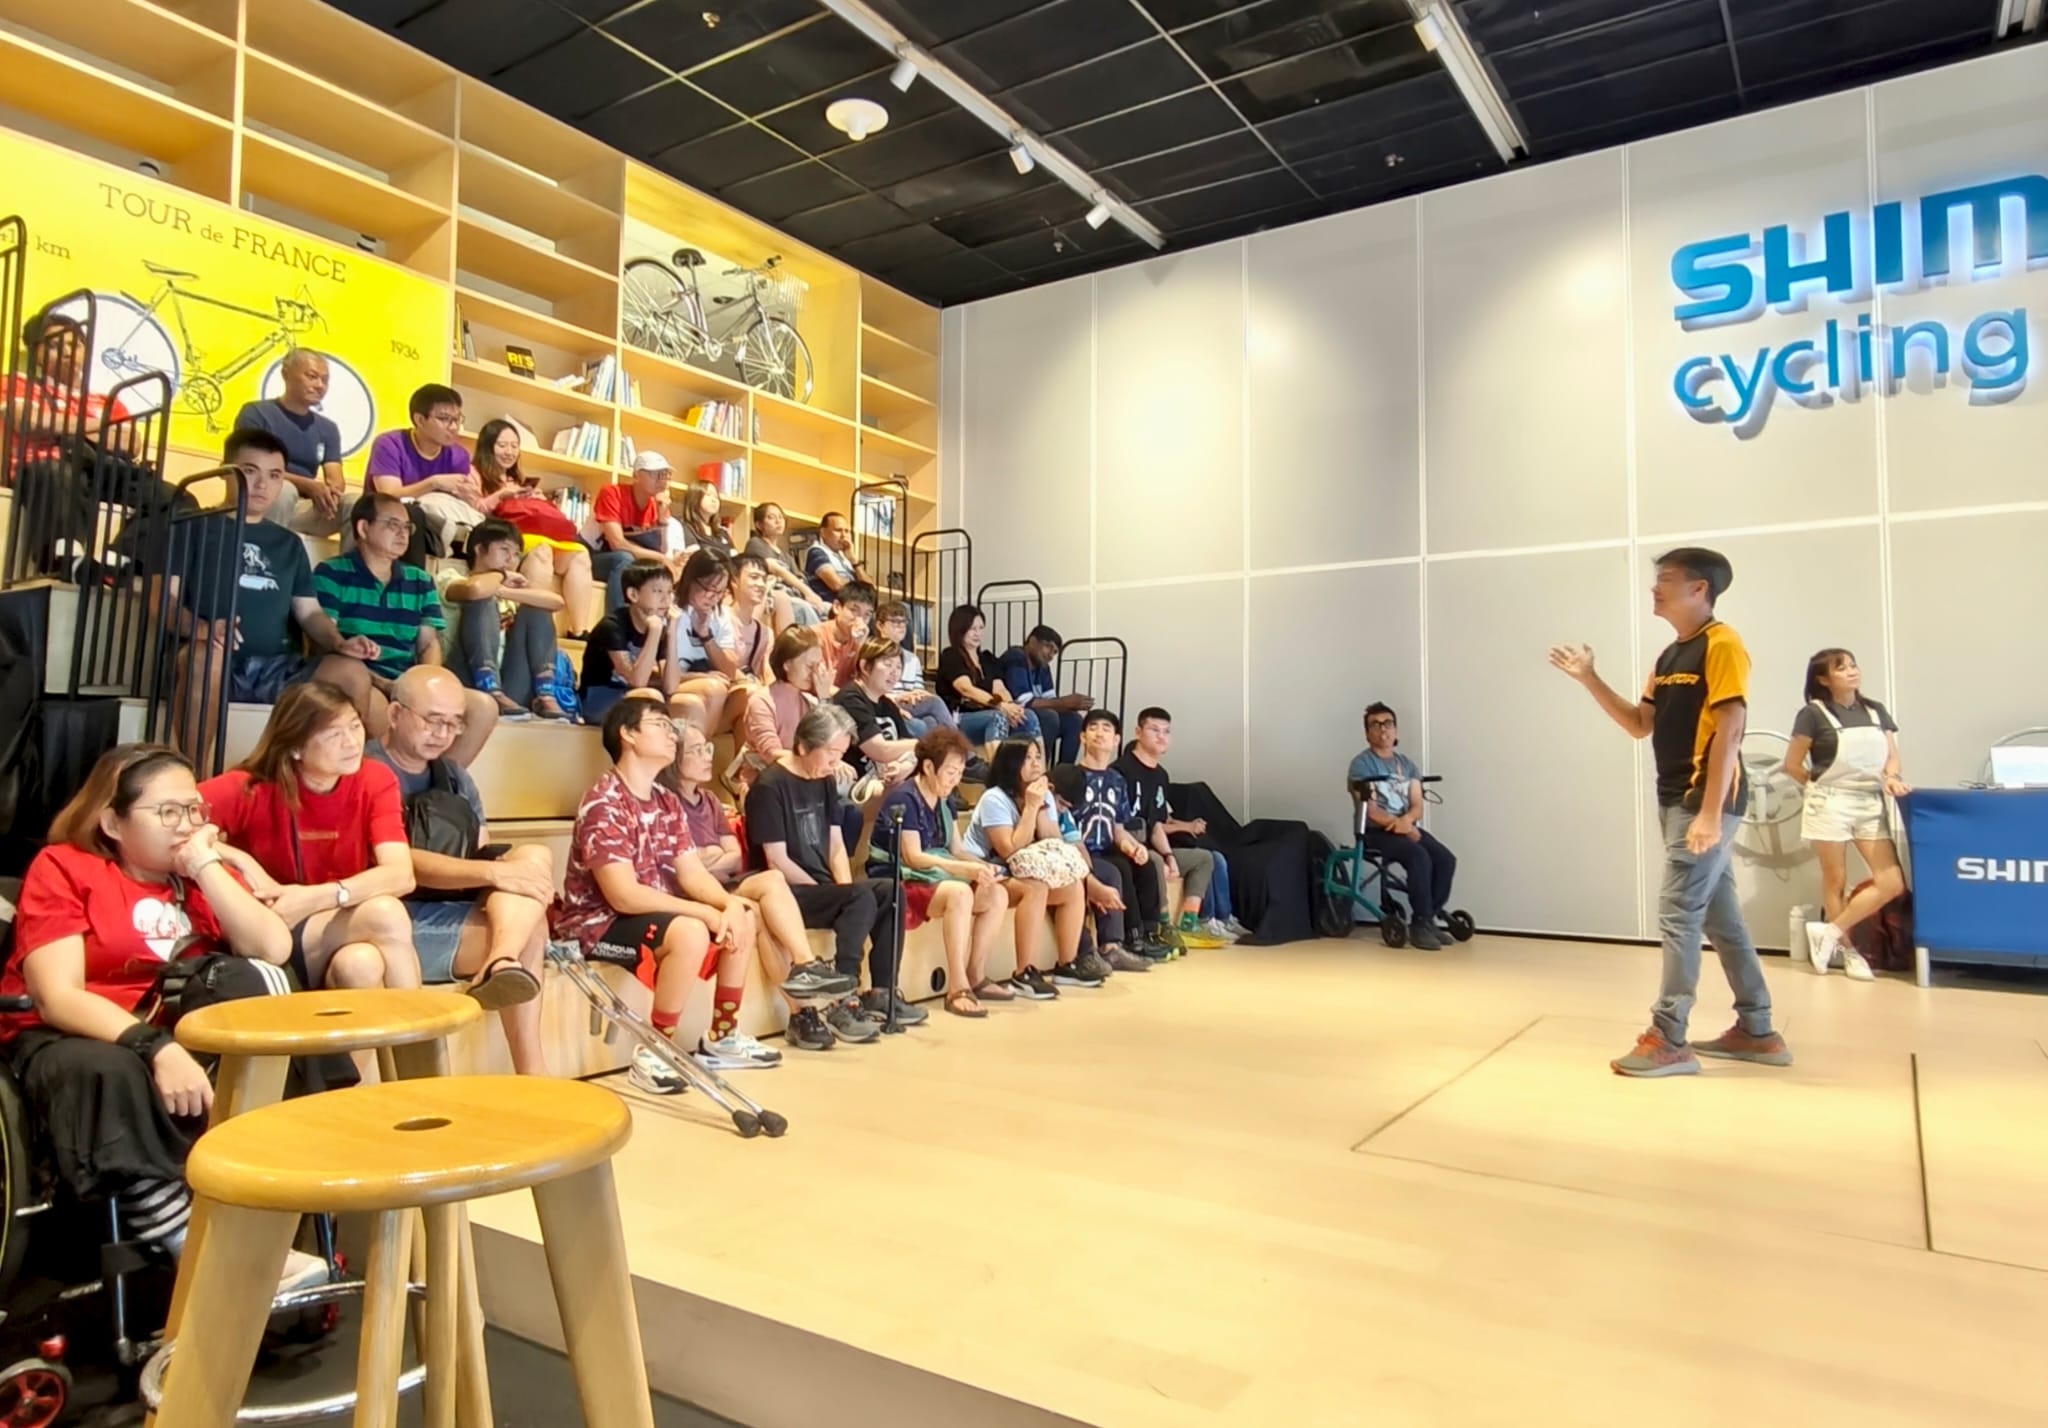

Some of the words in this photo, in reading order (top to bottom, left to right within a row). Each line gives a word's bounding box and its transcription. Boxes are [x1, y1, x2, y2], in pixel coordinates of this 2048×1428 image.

[36, 233, 72, 260] km
[99, 183, 192, 234] TOUR
[200, 225, 224, 243] de
[232, 227, 347, 283] FRANCE
[1673, 308, 2029, 422] cycling
